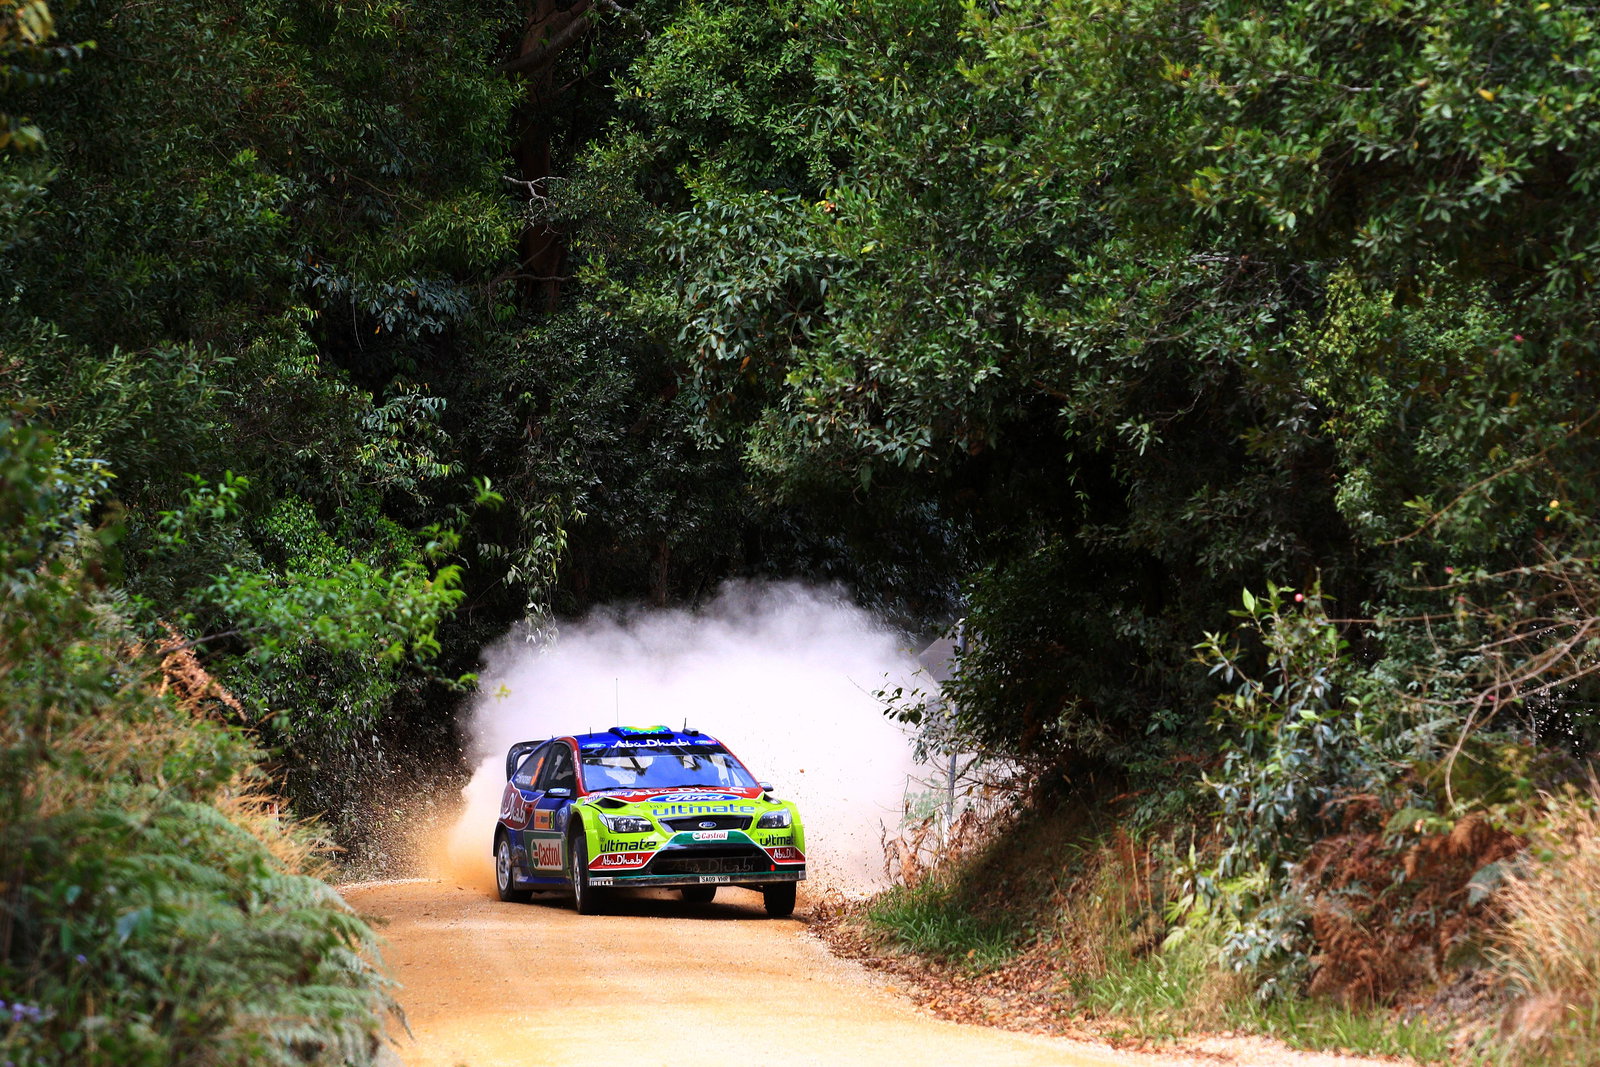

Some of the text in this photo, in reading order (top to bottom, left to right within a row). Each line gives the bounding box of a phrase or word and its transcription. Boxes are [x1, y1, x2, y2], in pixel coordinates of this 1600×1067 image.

[665, 792, 725, 801] Ford
[652, 804, 755, 816] ultimate
[600, 838, 657, 853] ultimate
[538, 843, 561, 866] Castrol
